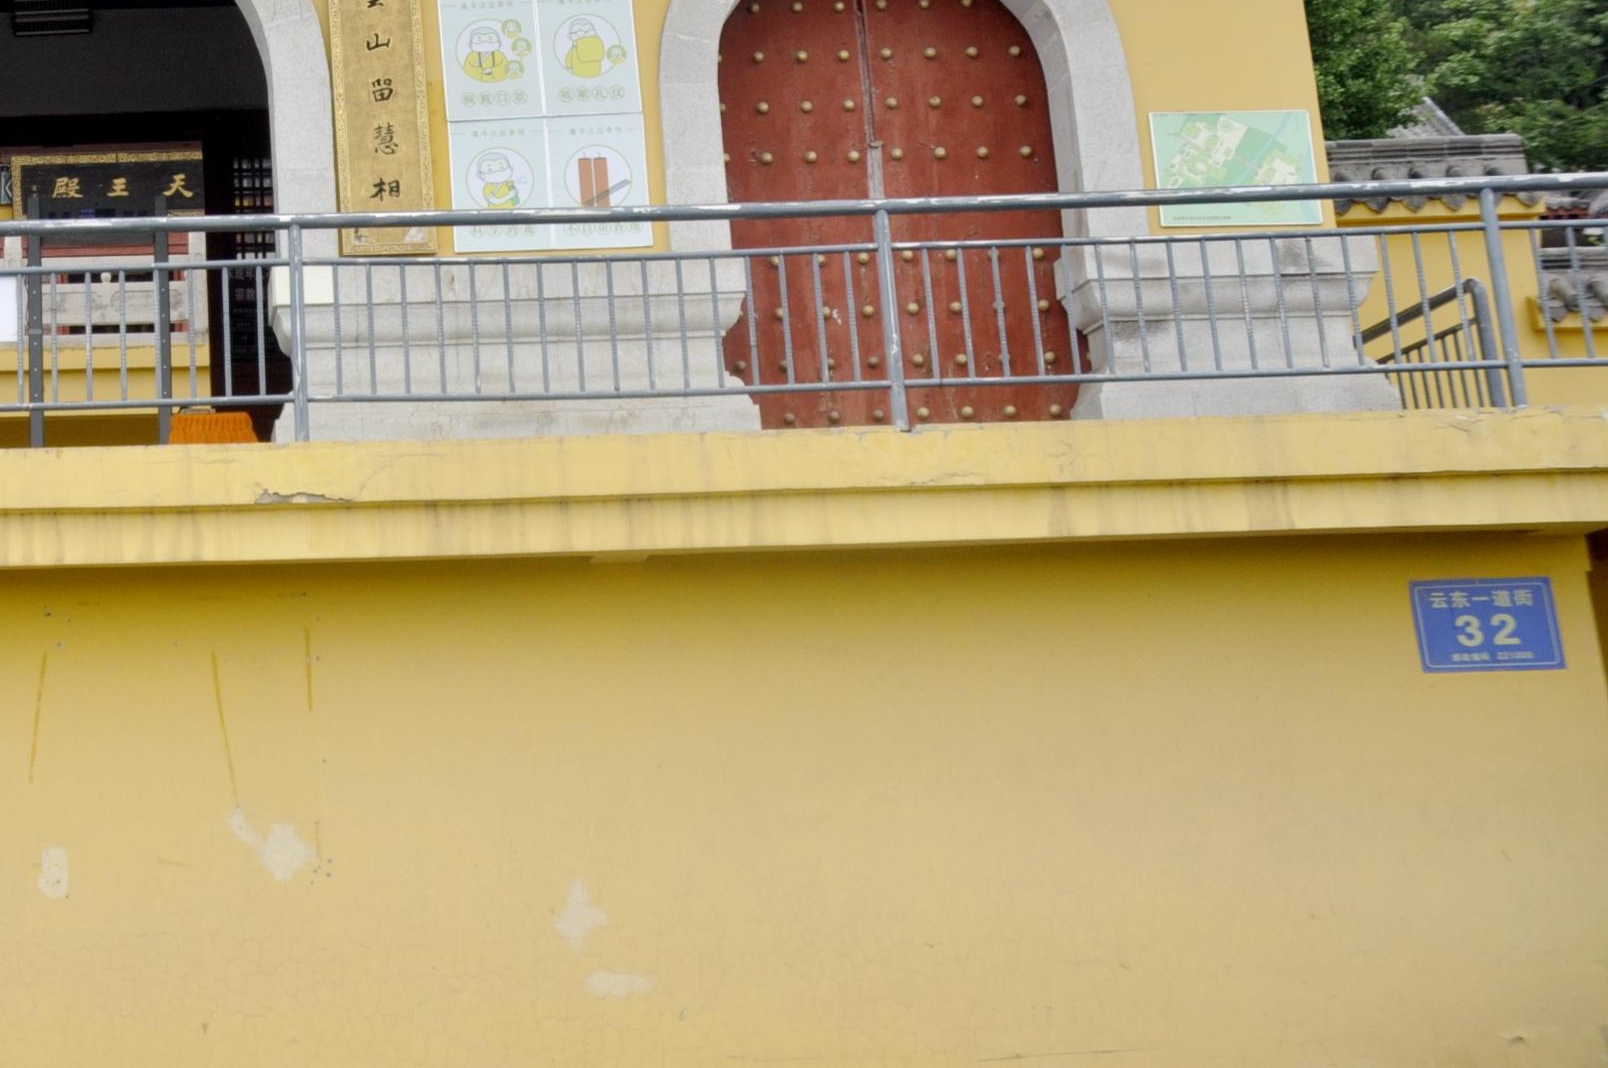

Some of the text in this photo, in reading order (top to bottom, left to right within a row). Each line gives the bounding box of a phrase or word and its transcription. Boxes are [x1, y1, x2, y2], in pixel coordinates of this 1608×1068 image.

[51, 173, 194, 199] 天王殿
[1429, 588, 1534, 609] 云东一道街
[1454, 613, 1522, 647] 32
